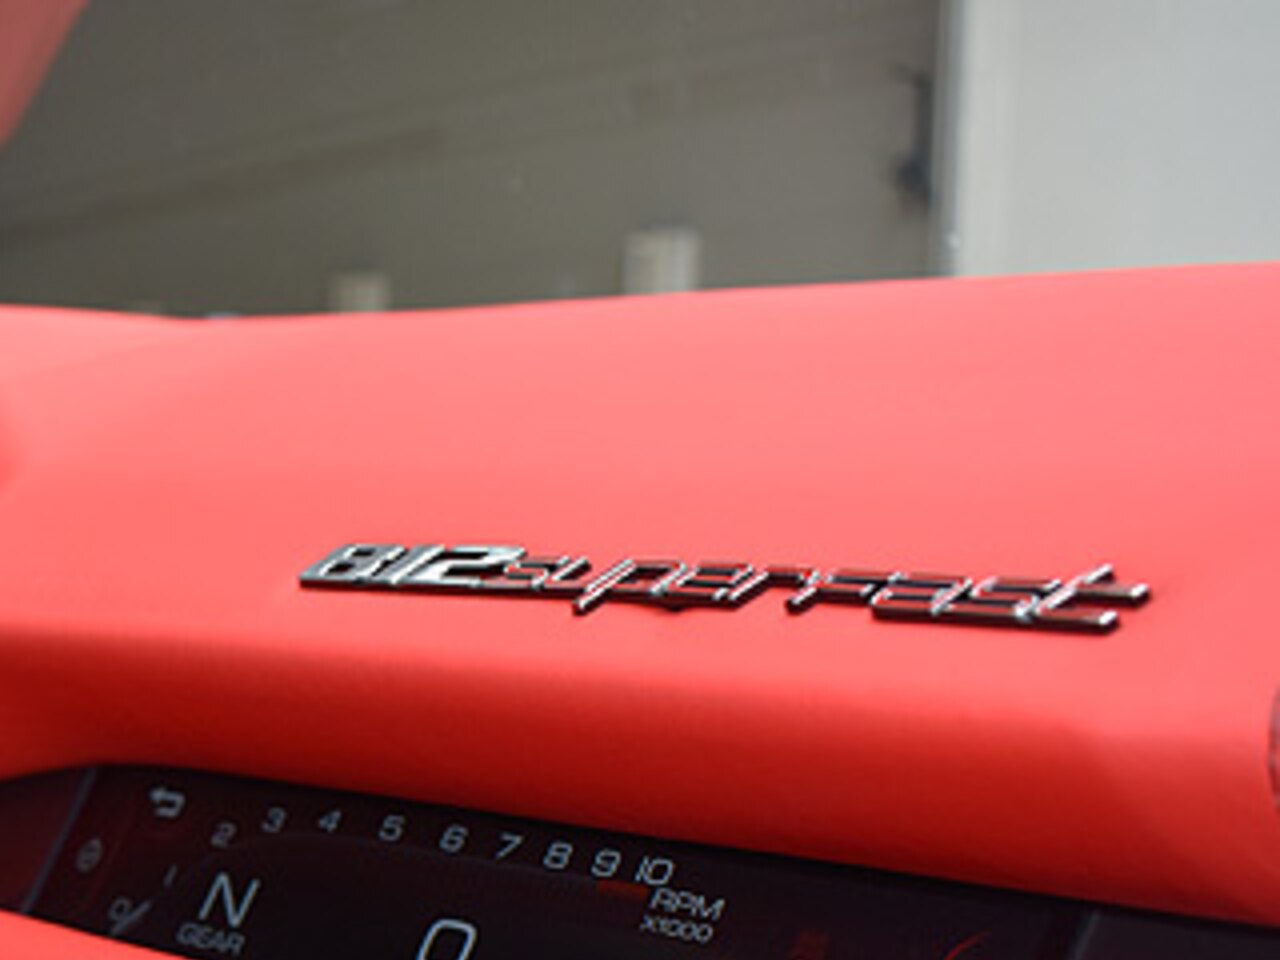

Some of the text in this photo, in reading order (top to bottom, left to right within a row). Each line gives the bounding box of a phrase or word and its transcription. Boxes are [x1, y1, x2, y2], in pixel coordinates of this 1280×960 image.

[210, 821, 237, 847] 2
[261, 806, 287, 833] 3
[318, 809, 342, 832] 4
[378, 815, 405, 841] 5
[439, 825, 468, 852] 6
[496, 833, 523, 859] 7
[542, 842, 573, 870] 8
[591, 849, 621, 878] 9
[634, 856, 675, 886] 10
[197, 871, 261, 929] N
[649, 888, 726, 921] RPM
[175, 922, 246, 956] GEAR
